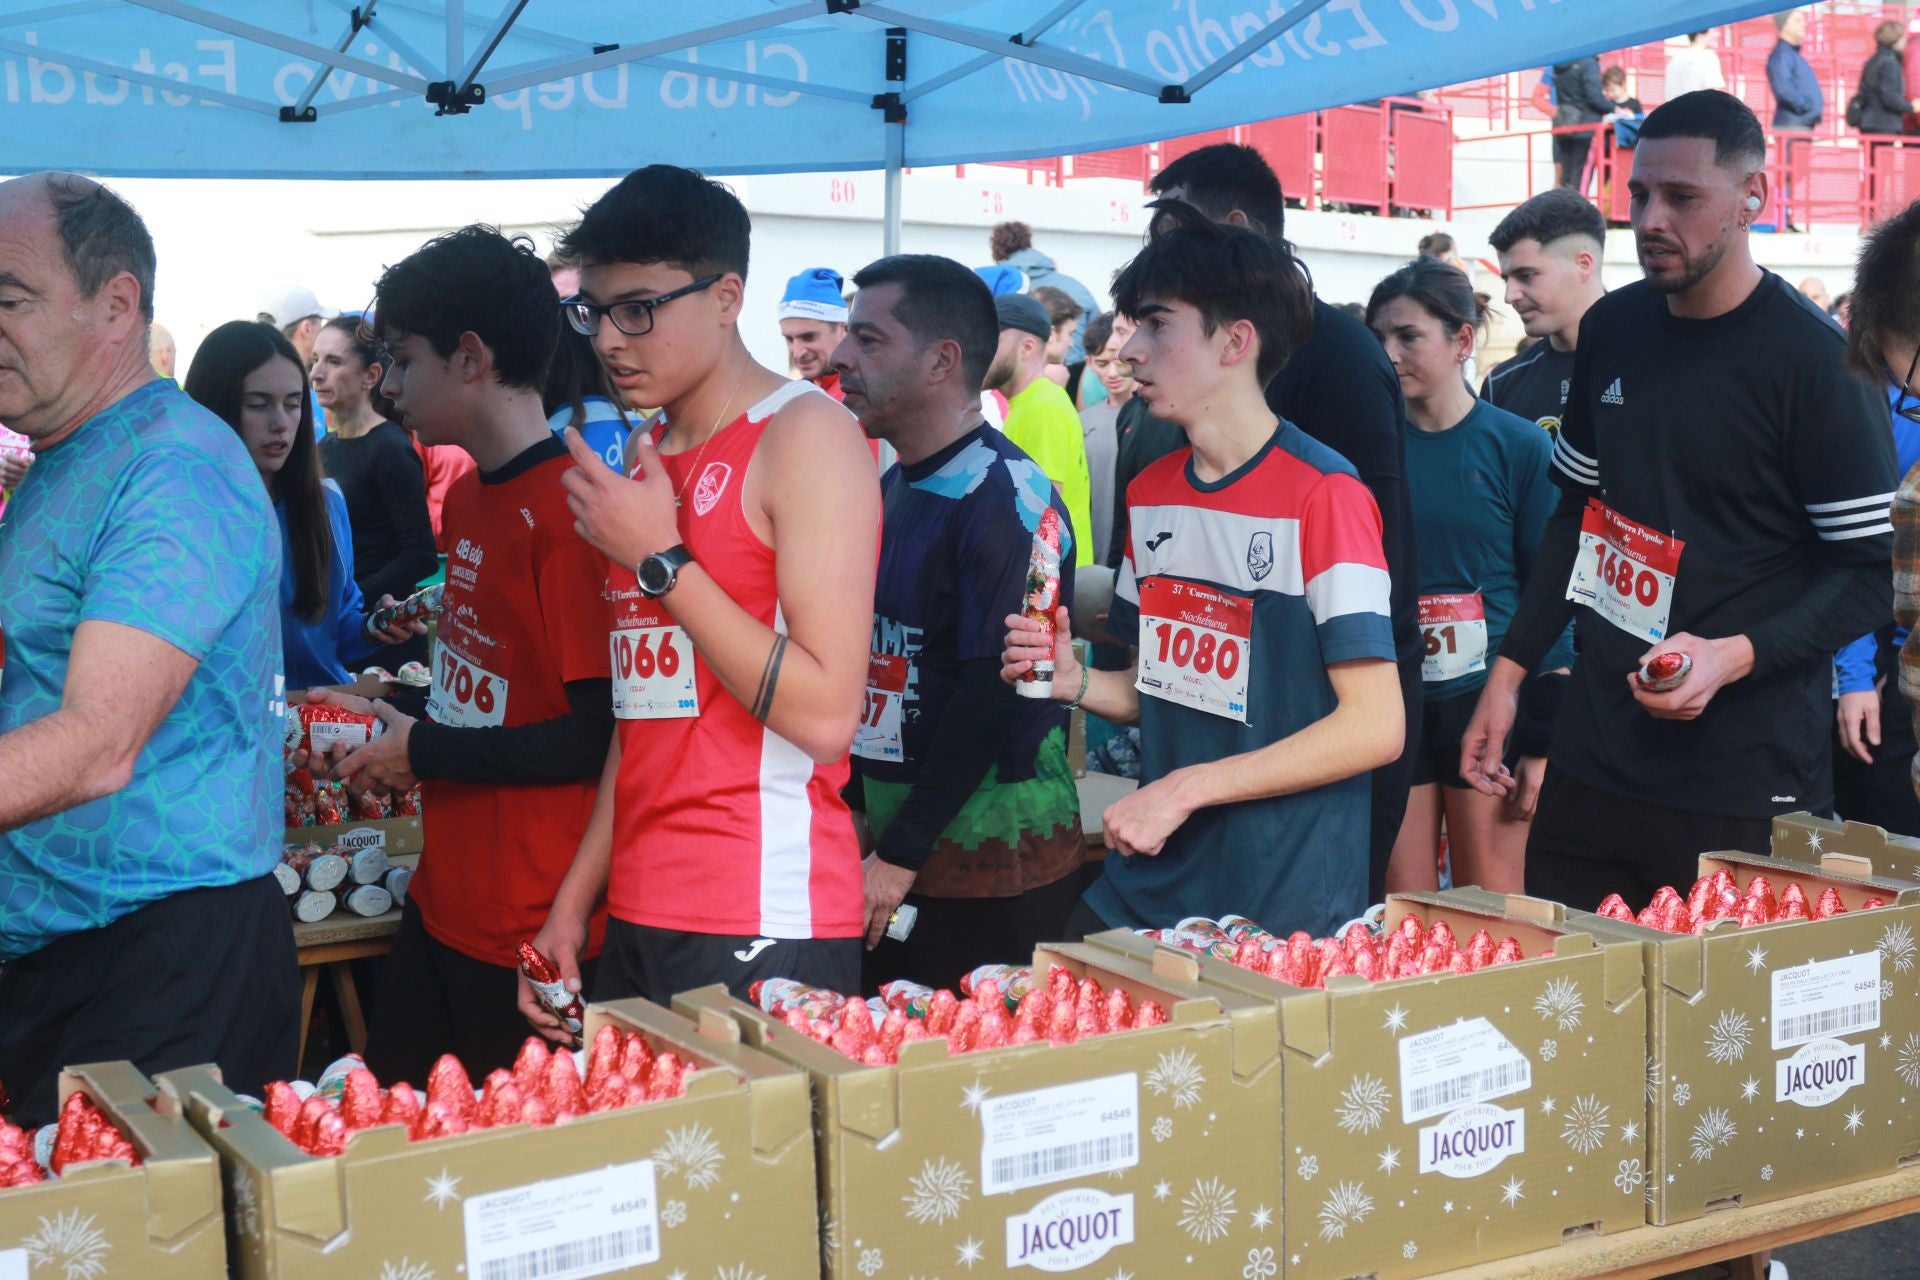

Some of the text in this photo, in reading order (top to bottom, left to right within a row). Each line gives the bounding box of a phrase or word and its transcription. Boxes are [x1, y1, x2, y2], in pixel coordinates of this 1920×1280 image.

[830, 179, 855, 204] 80
[1600, 394, 1624, 405] adidas
[1623, 533, 1632, 543] de
[1637, 527, 1665, 546] Popular
[1594, 542, 1660, 607] 1680
[629, 602, 638, 611] de
[1204, 604, 1214, 613] de
[1432, 597, 1463, 605] Popular
[1179, 610, 1228, 631] Nochebuena
[613, 631, 680, 681] 1066
[1155, 622, 1240, 681] 1080
[440, 649, 494, 714] 1706
[342, 835, 381, 848] JACQUOT
[1780, 969, 1811, 982] JACQUOT
[1854, 979, 1876, 992] 64549
[1408, 1031, 1445, 1048] JACQUOT
[1784, 1055, 1857, 1096] JACQUOT
[992, 1097, 1037, 1113] JACQUOT
[1100, 1108, 1132, 1123] 64549
[1430, 1119, 1516, 1165] JACQUOT
[477, 1191, 532, 1211] JACQUOT
[610, 1198, 648, 1216] 64549
[1018, 1207, 1122, 1259] JACQUOT
